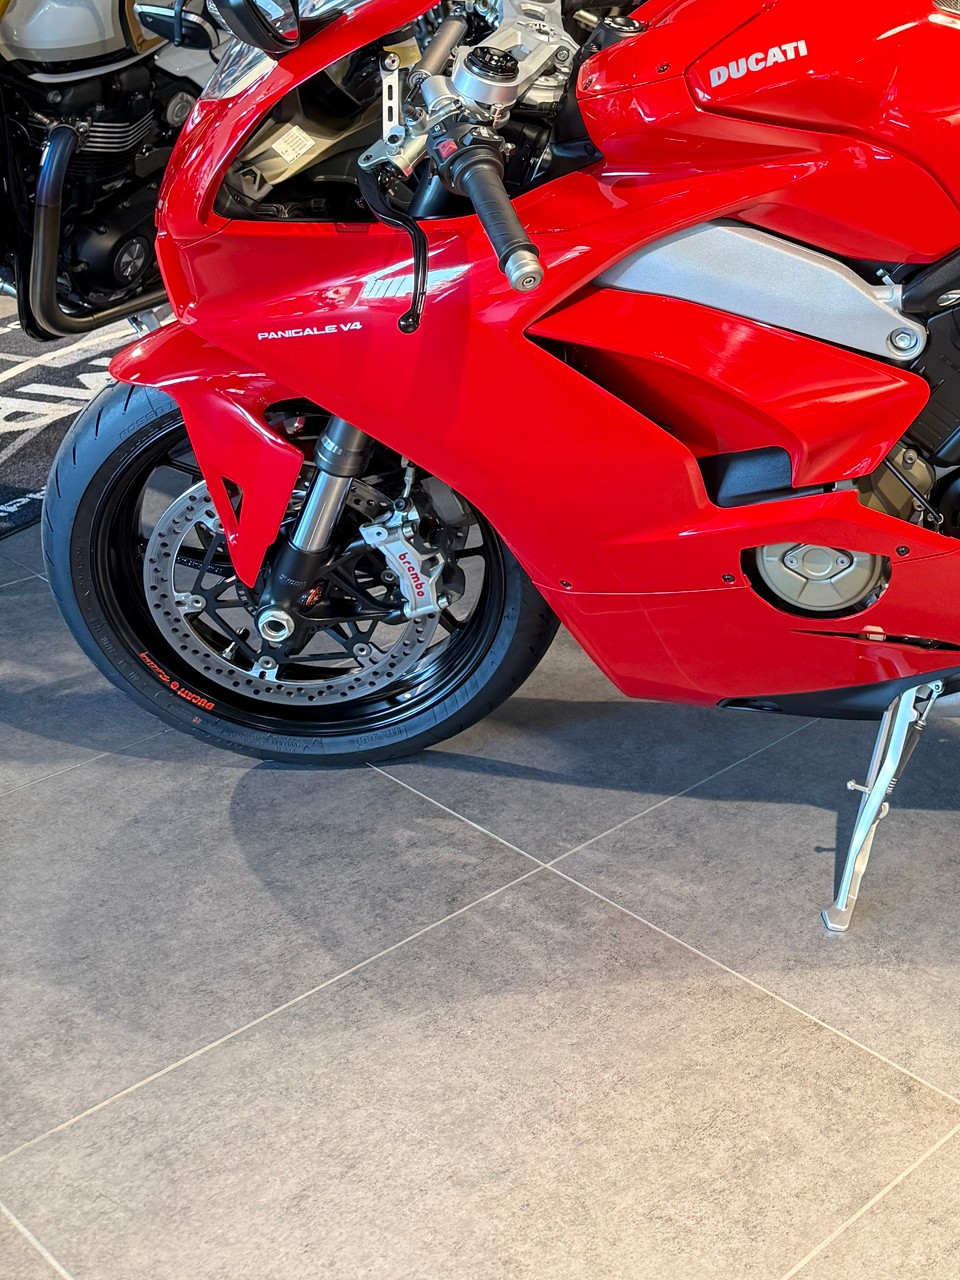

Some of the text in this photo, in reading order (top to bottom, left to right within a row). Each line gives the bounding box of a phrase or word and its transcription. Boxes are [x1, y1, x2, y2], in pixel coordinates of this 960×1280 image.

[709, 39, 808, 88] DUCATI
[257, 321, 363, 340] PANIGALE V4
[398, 552, 426, 597] brembo
[177, 687, 215, 711] DUCATI
